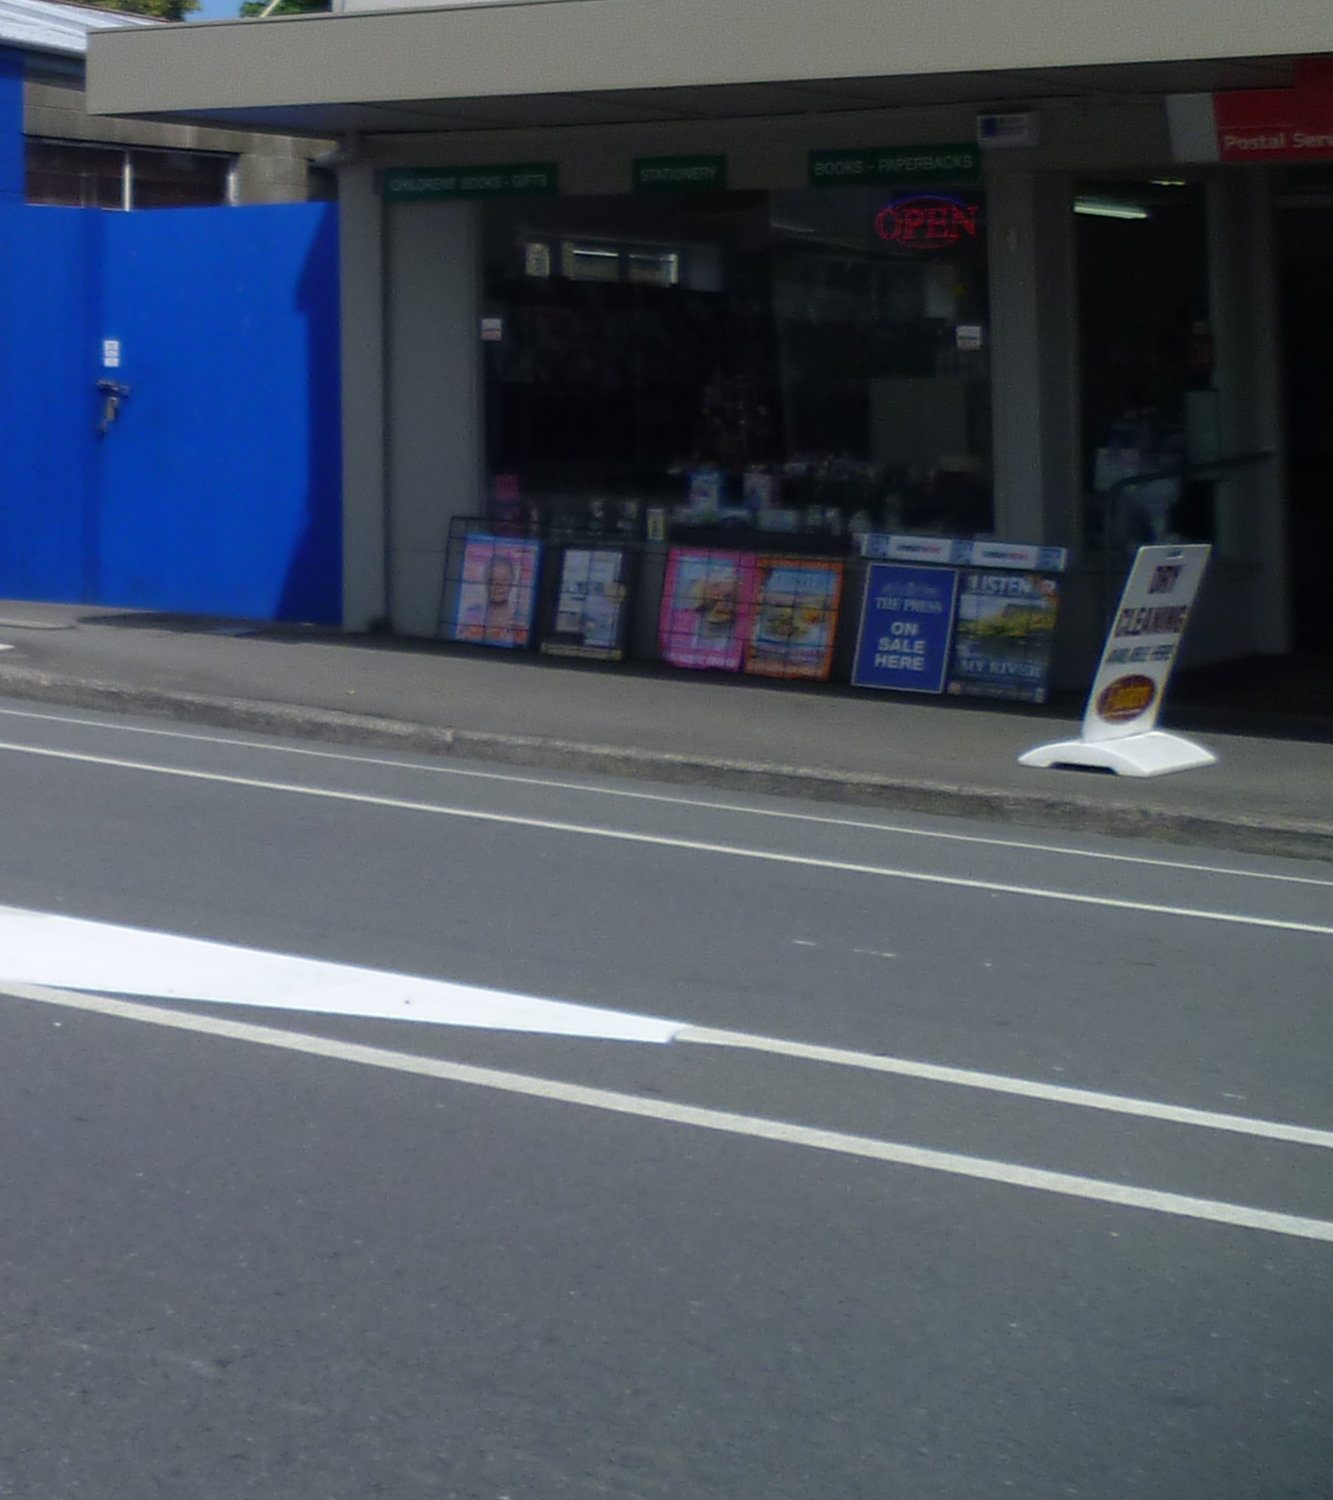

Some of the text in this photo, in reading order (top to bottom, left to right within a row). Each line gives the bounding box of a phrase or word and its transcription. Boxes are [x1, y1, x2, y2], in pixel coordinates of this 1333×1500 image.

[1224, 132, 1285, 150] Postal
[874, 204, 979, 241] OPEN
[968, 575, 1057, 595] LISTENR
[891, 621, 918, 636] ON
[878, 637, 926, 655] SALE
[874, 655, 925, 671] HERE
